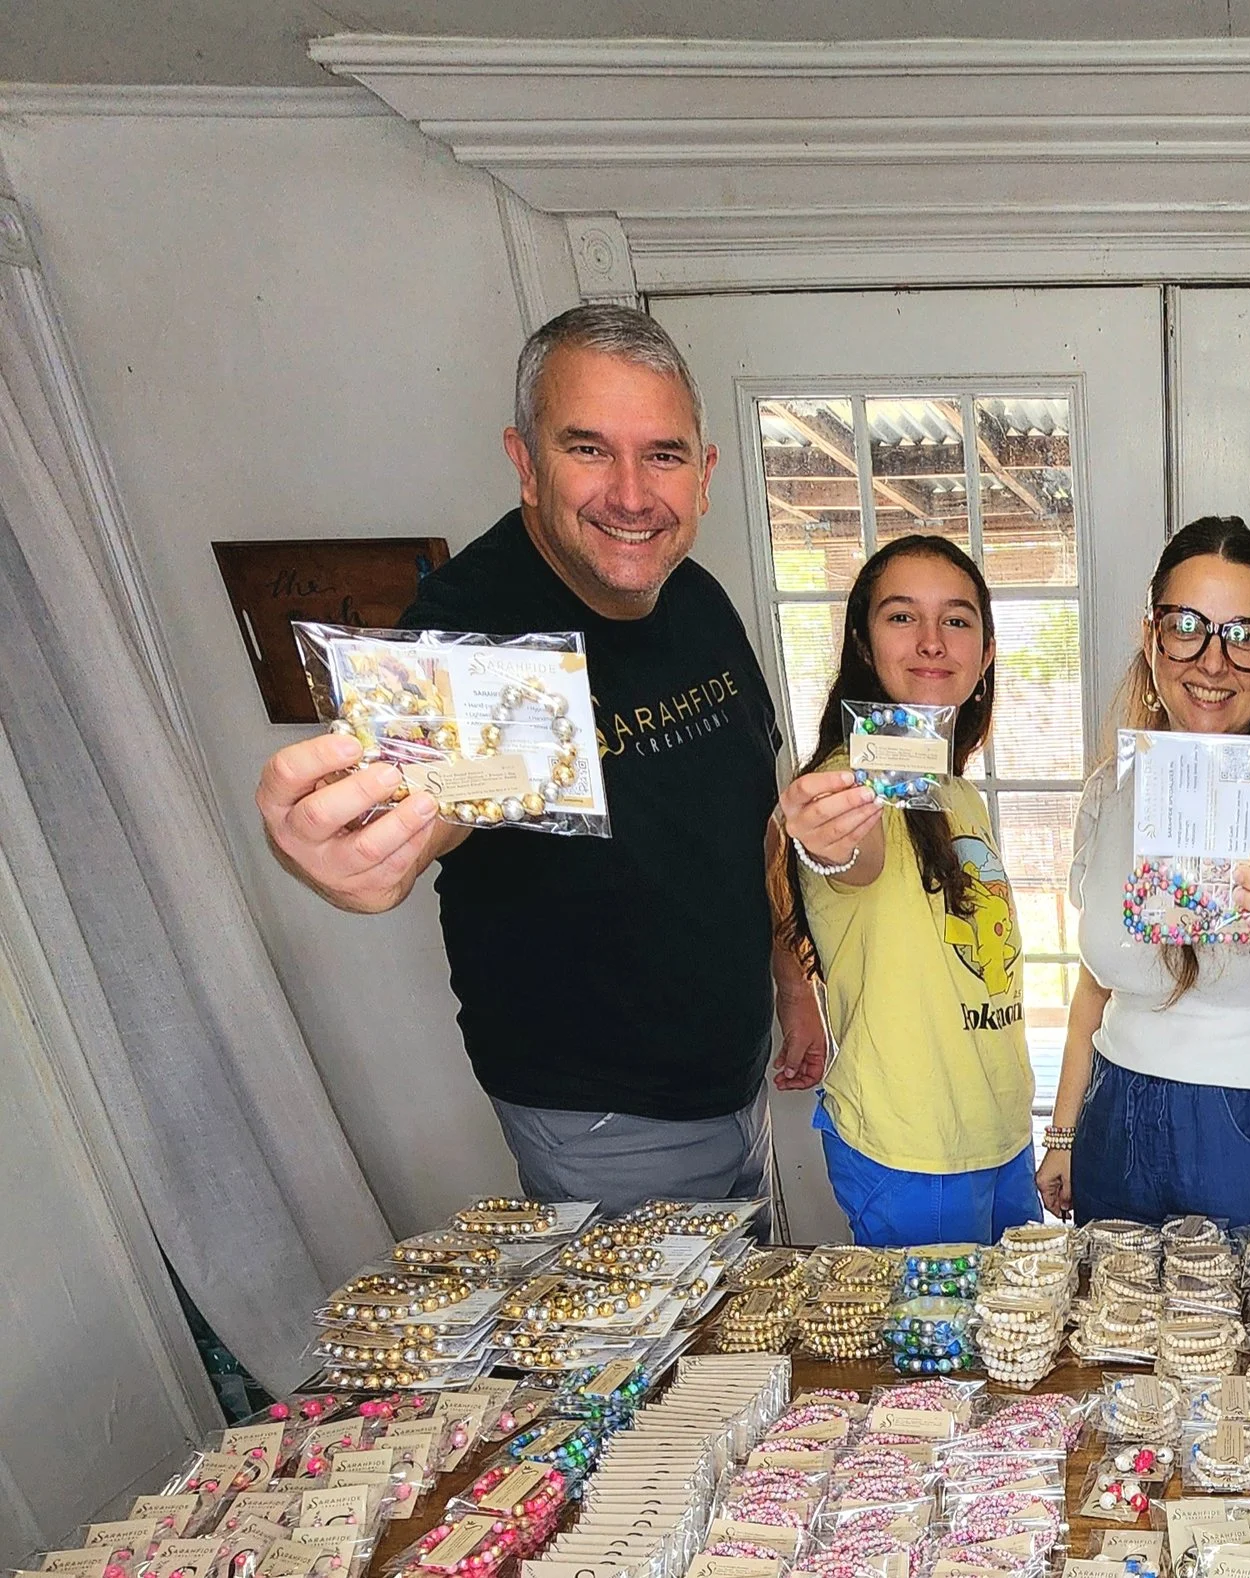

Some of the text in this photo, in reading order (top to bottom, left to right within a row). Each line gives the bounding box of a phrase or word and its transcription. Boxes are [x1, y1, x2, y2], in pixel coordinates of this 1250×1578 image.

[636, 709, 729, 756] CREATIONS
[306, 1497, 360, 1510] SARAHFIDE
[1173, 1508, 1220, 1520] SARAHFIDE
[1201, 1531, 1247, 1544] SARAHFIDE
